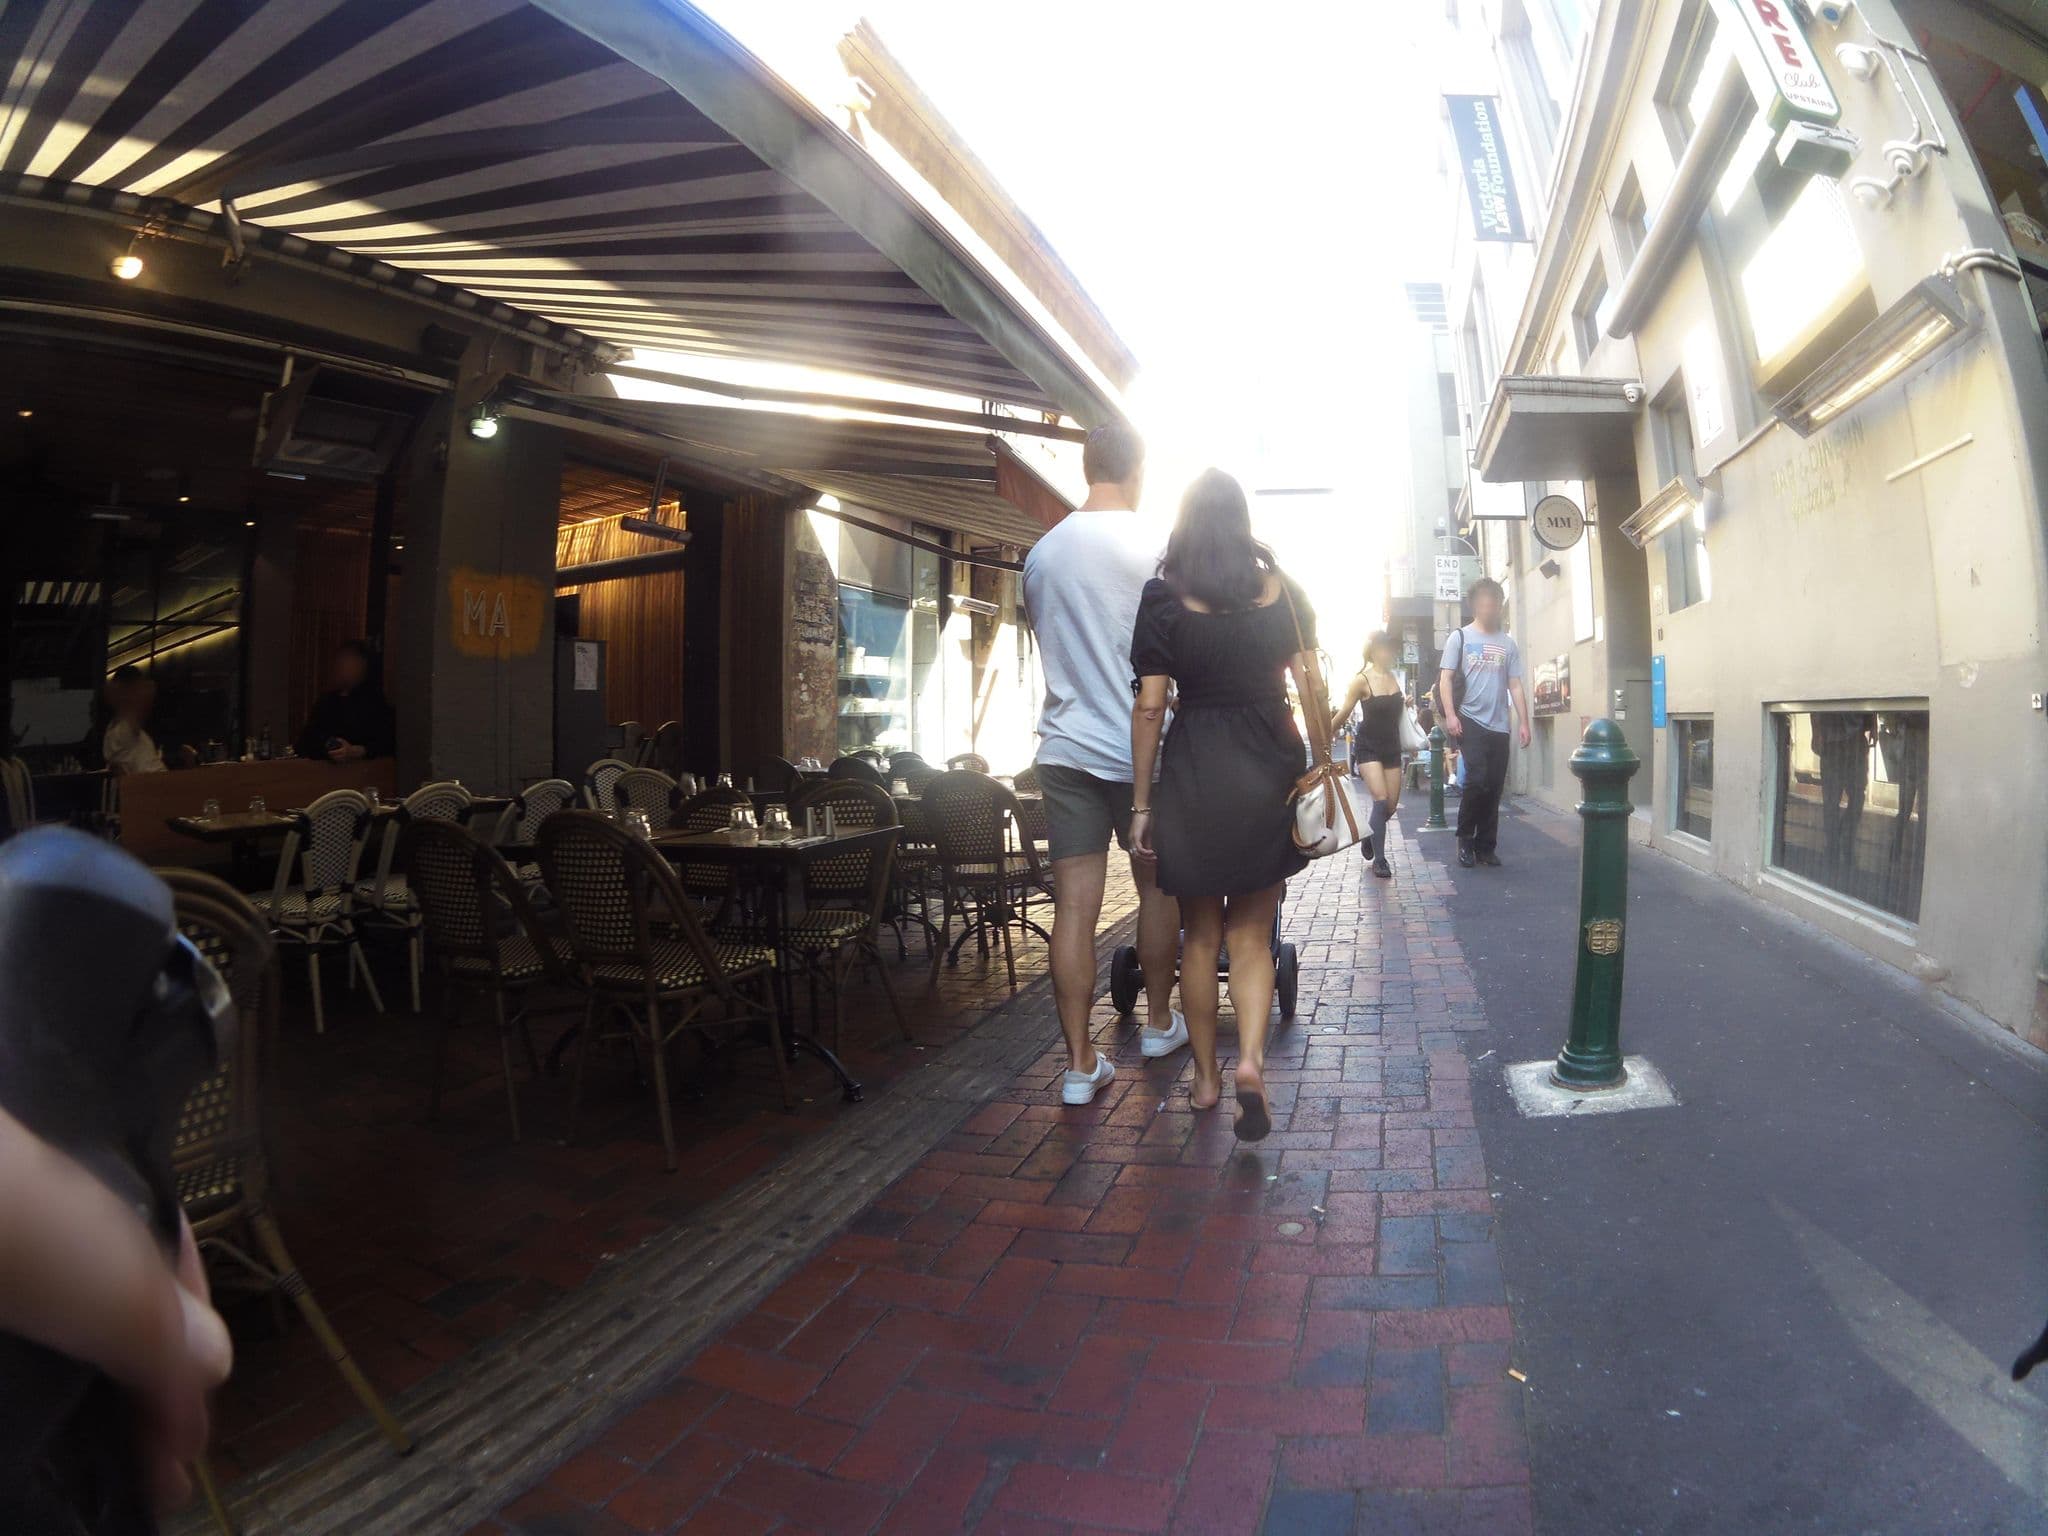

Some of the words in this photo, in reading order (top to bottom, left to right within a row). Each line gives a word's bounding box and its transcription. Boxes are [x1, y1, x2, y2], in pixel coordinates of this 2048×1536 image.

[1784, 72, 1821, 88] Club
[1785, 92, 1834, 109] UPSTAIRS
[1473, 100, 1507, 195] Foundation
[1472, 158, 1498, 228] Victoria
[1495, 195, 1511, 235] Law
[1546, 517, 1571, 528] MM
[1437, 559, 1458, 568] END
[463, 588, 511, 638] MA
